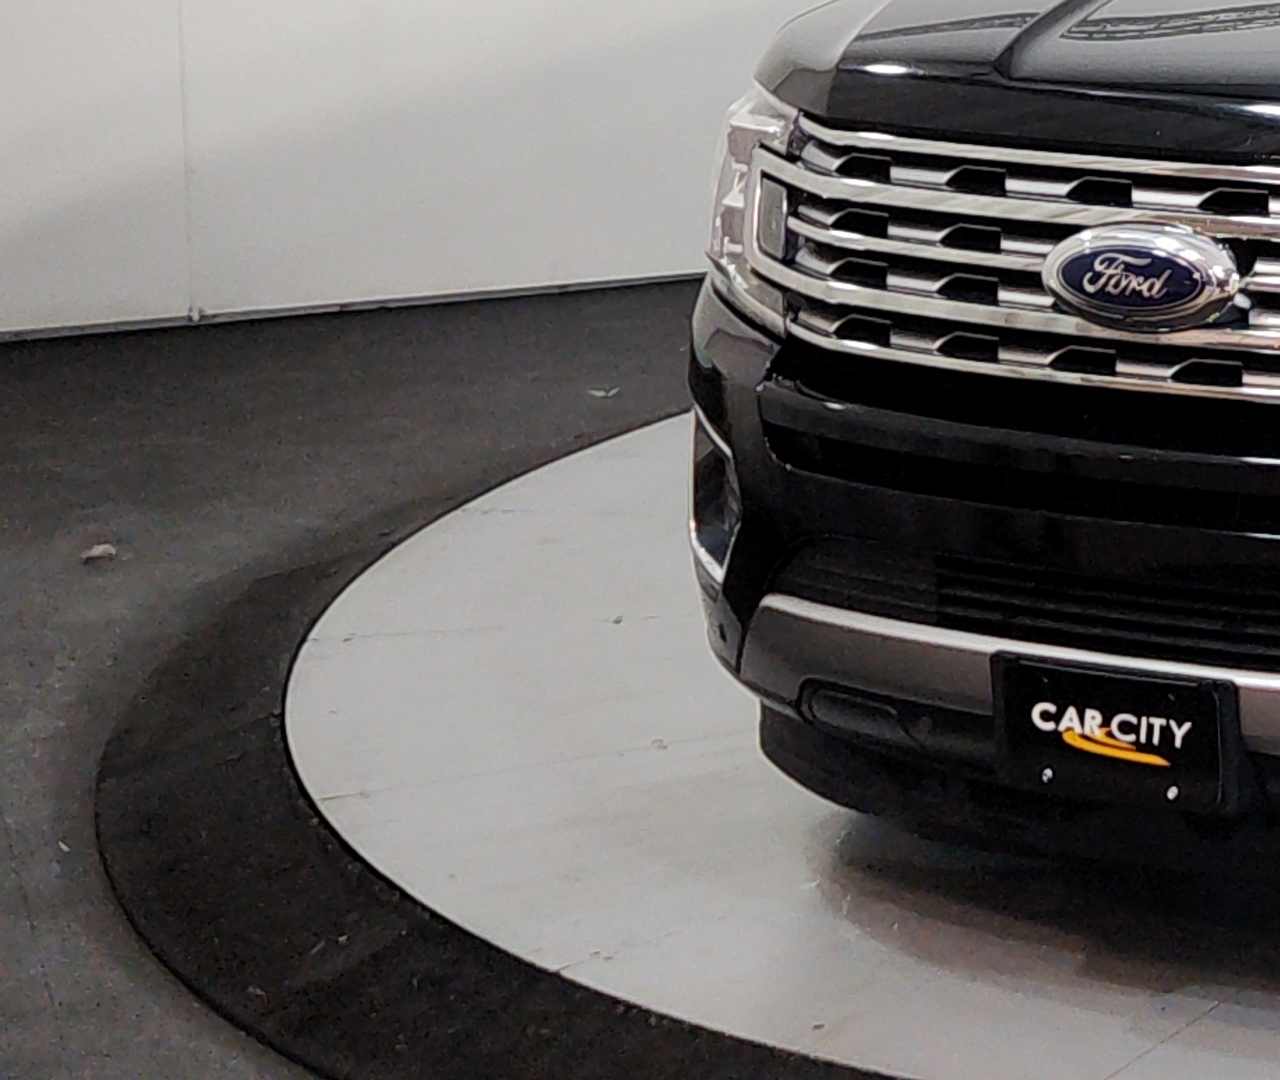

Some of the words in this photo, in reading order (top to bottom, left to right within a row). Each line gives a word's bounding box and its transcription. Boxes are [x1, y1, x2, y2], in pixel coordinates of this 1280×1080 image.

[1083, 252, 1172, 298] Ford
[1031, 702, 1103, 736] CAR
[1110, 713, 1192, 749] CITY
